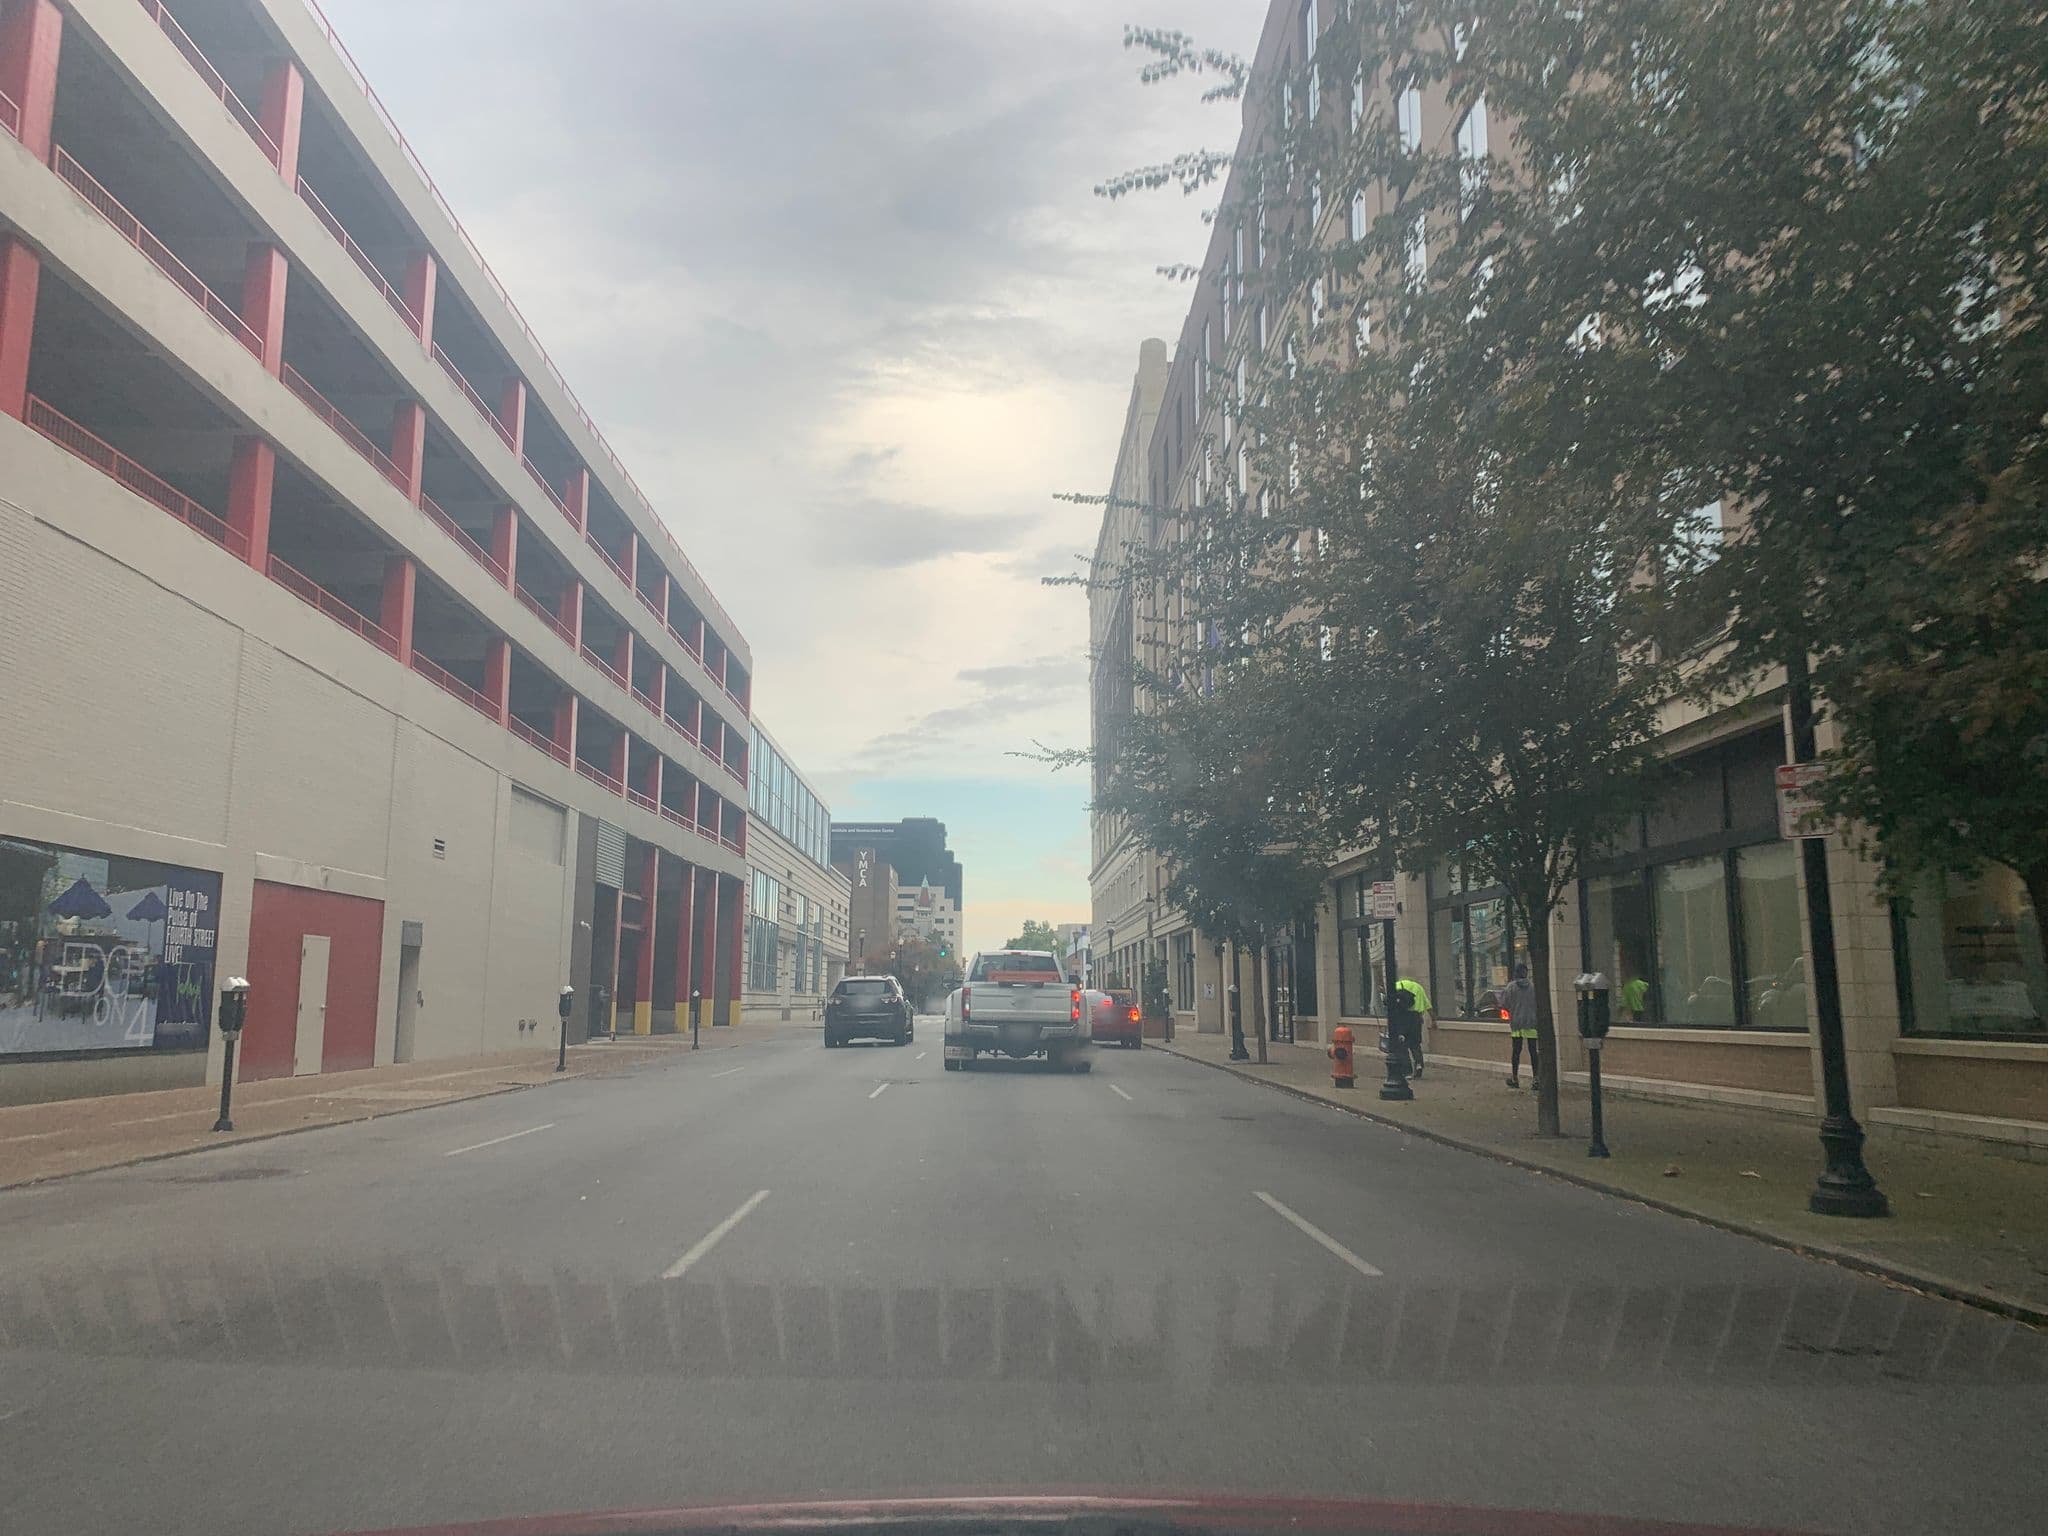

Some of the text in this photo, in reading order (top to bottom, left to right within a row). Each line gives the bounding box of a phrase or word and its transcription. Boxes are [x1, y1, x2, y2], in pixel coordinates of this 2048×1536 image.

[858, 851, 868, 887] YMCA
[169, 888, 209, 911] Live On The
[167, 907, 198, 928] Pulse of
[166, 925, 215, 948] FOURTH STREET
[125, 996, 154, 1047] 4
